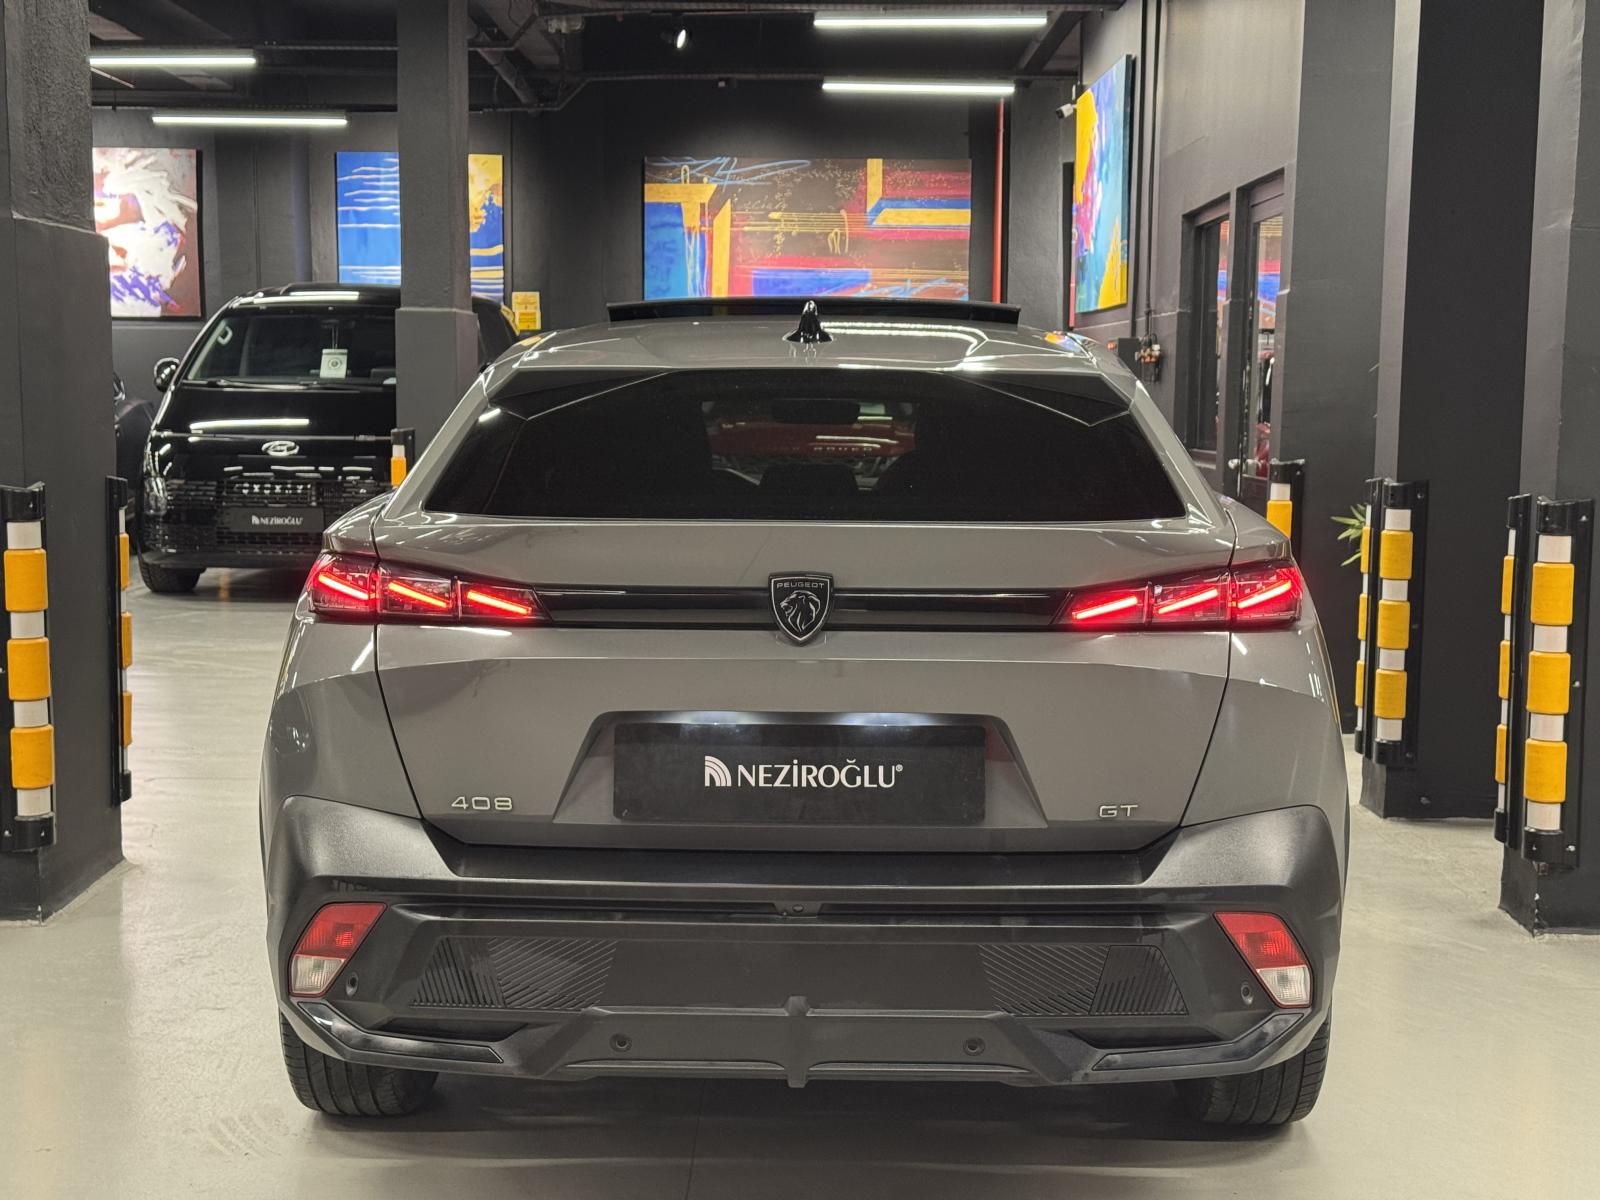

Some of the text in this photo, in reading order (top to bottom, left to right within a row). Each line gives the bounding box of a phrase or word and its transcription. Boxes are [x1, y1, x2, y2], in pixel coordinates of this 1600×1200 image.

[776, 581, 825, 589] PEUGEOT
[451, 796, 513, 811] 408
[1099, 804, 1139, 818] GT
